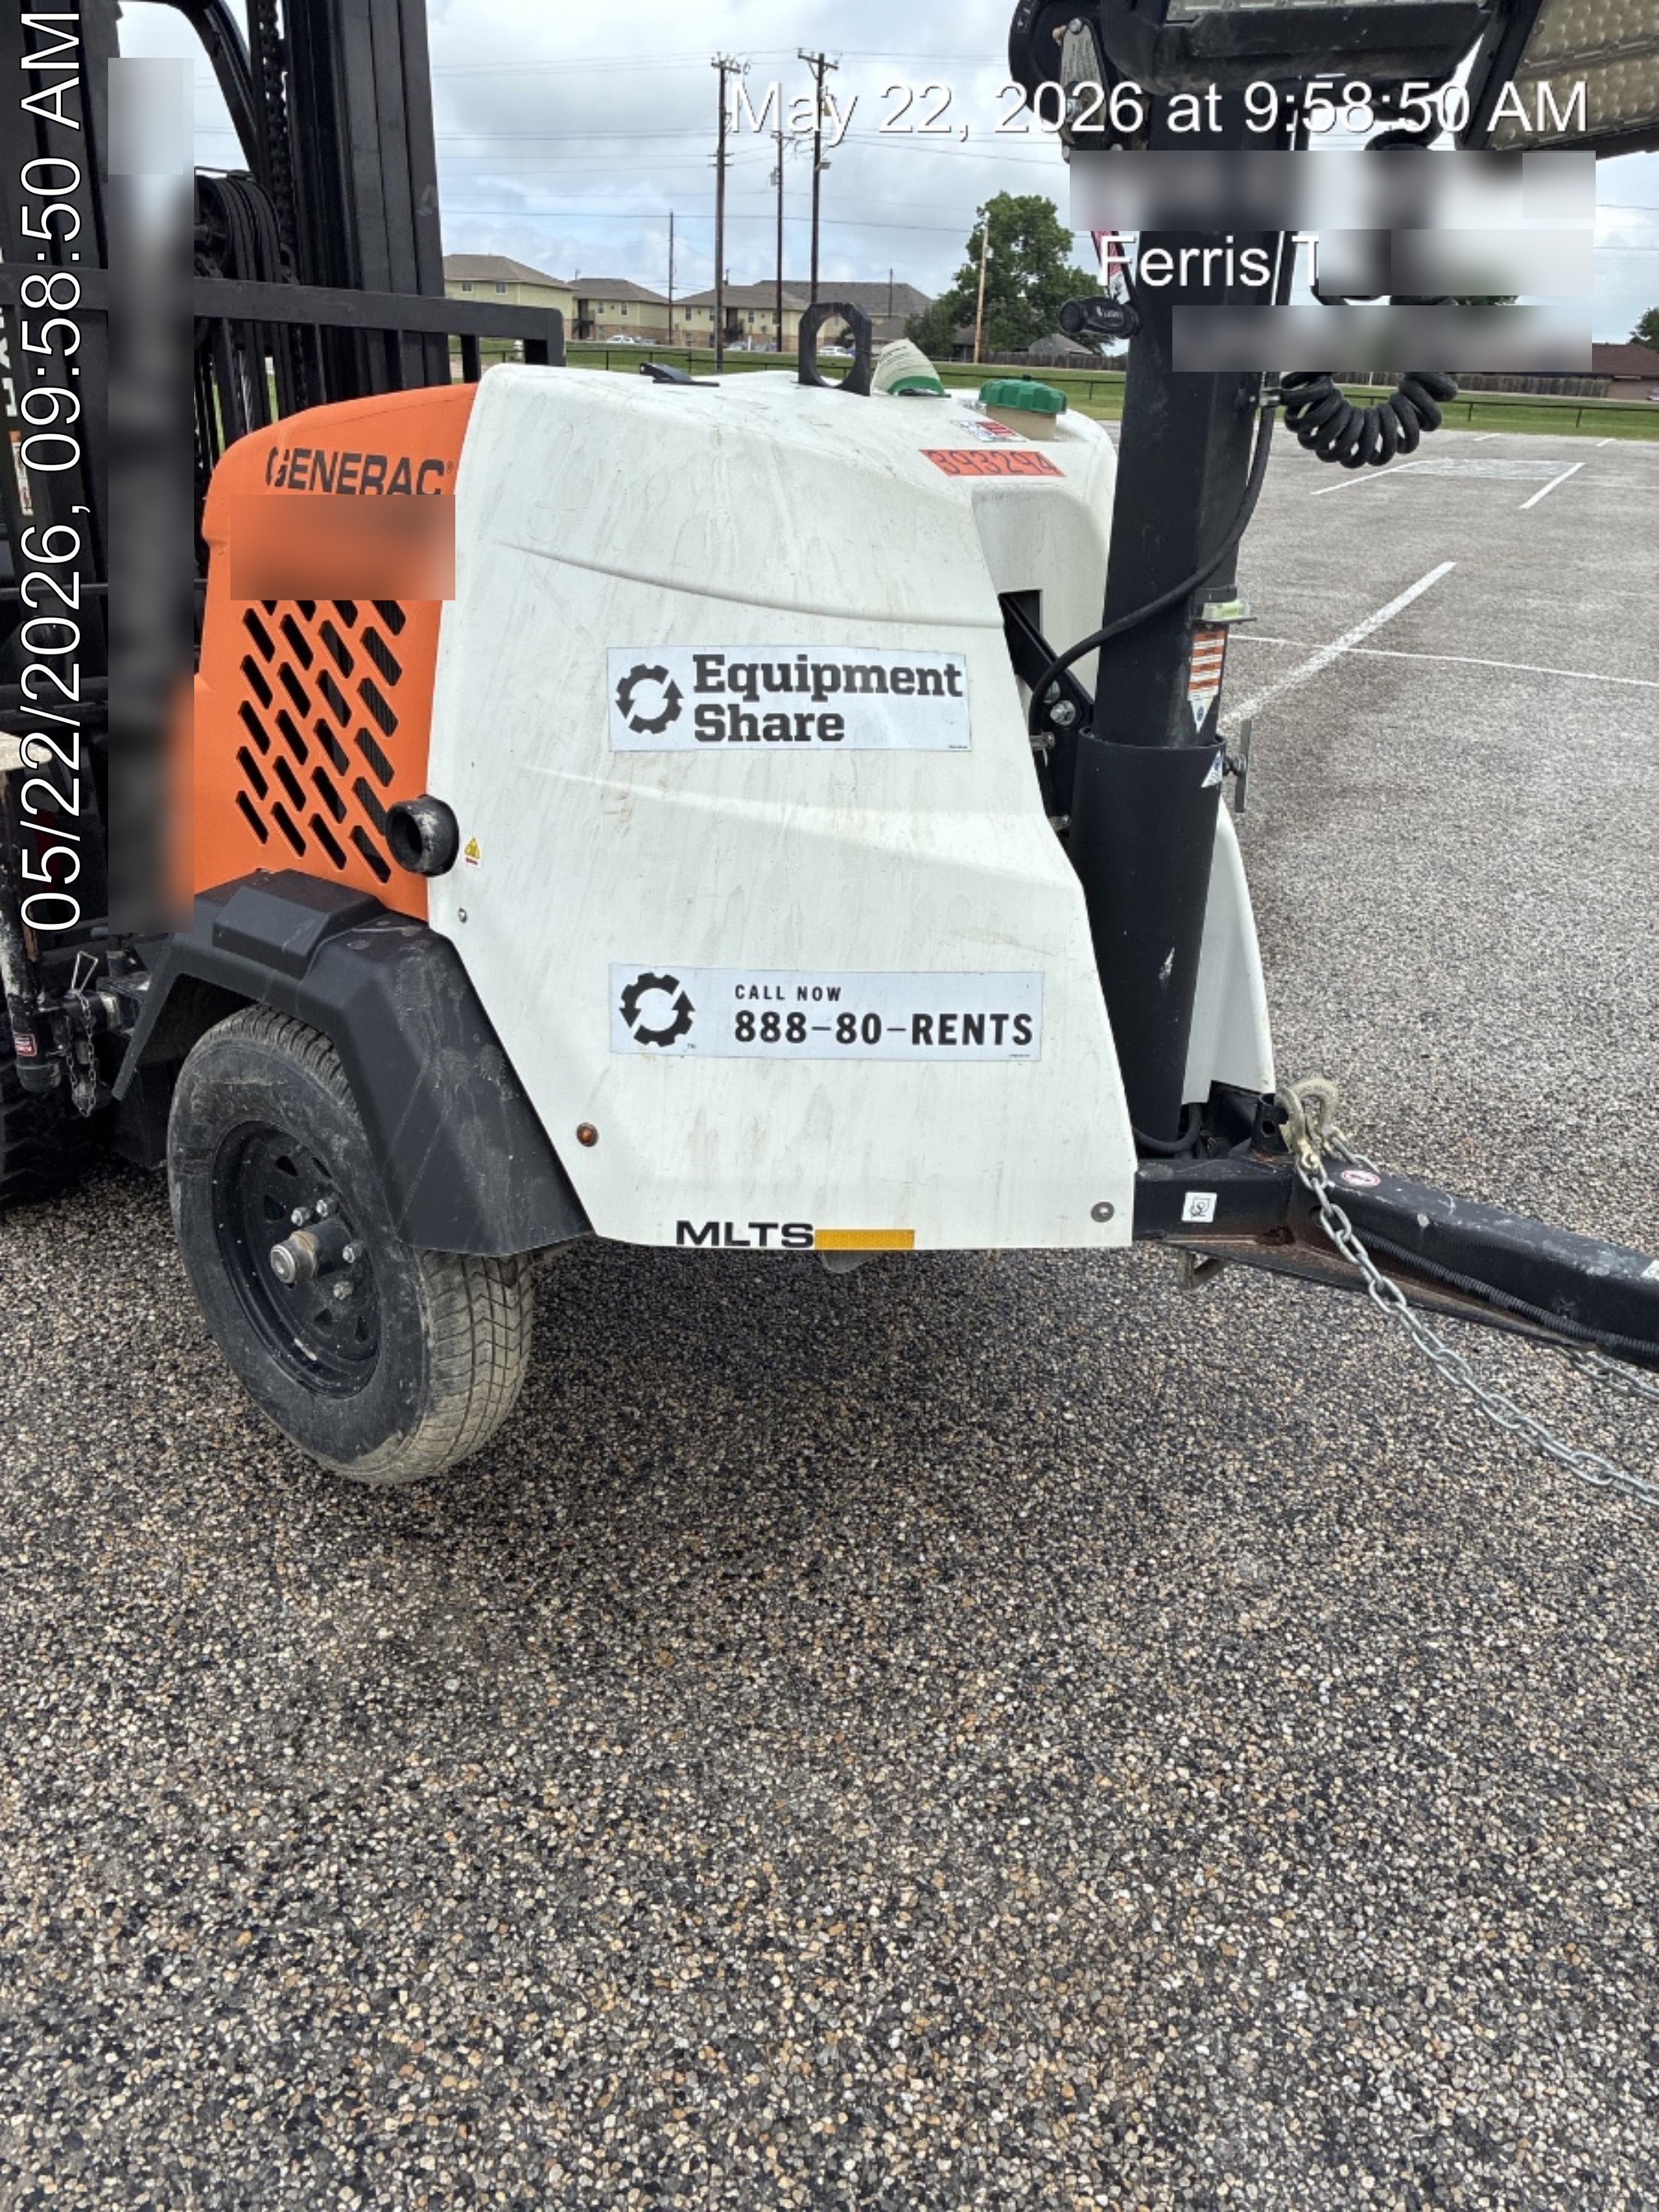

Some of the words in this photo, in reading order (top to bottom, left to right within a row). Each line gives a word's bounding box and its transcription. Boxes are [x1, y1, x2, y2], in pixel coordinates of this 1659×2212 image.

[265, 447, 445, 495] GENERAC
[925, 451, 1062, 475] 393294
[692, 654, 963, 702] Equipment
[694, 704, 845, 742] Share
[735, 984, 786, 1000] CALL
[796, 986, 841, 1002] NOW
[734, 1010, 1033, 1046] 888-80-RENTS
[677, 1220, 814, 1249] MLTS
